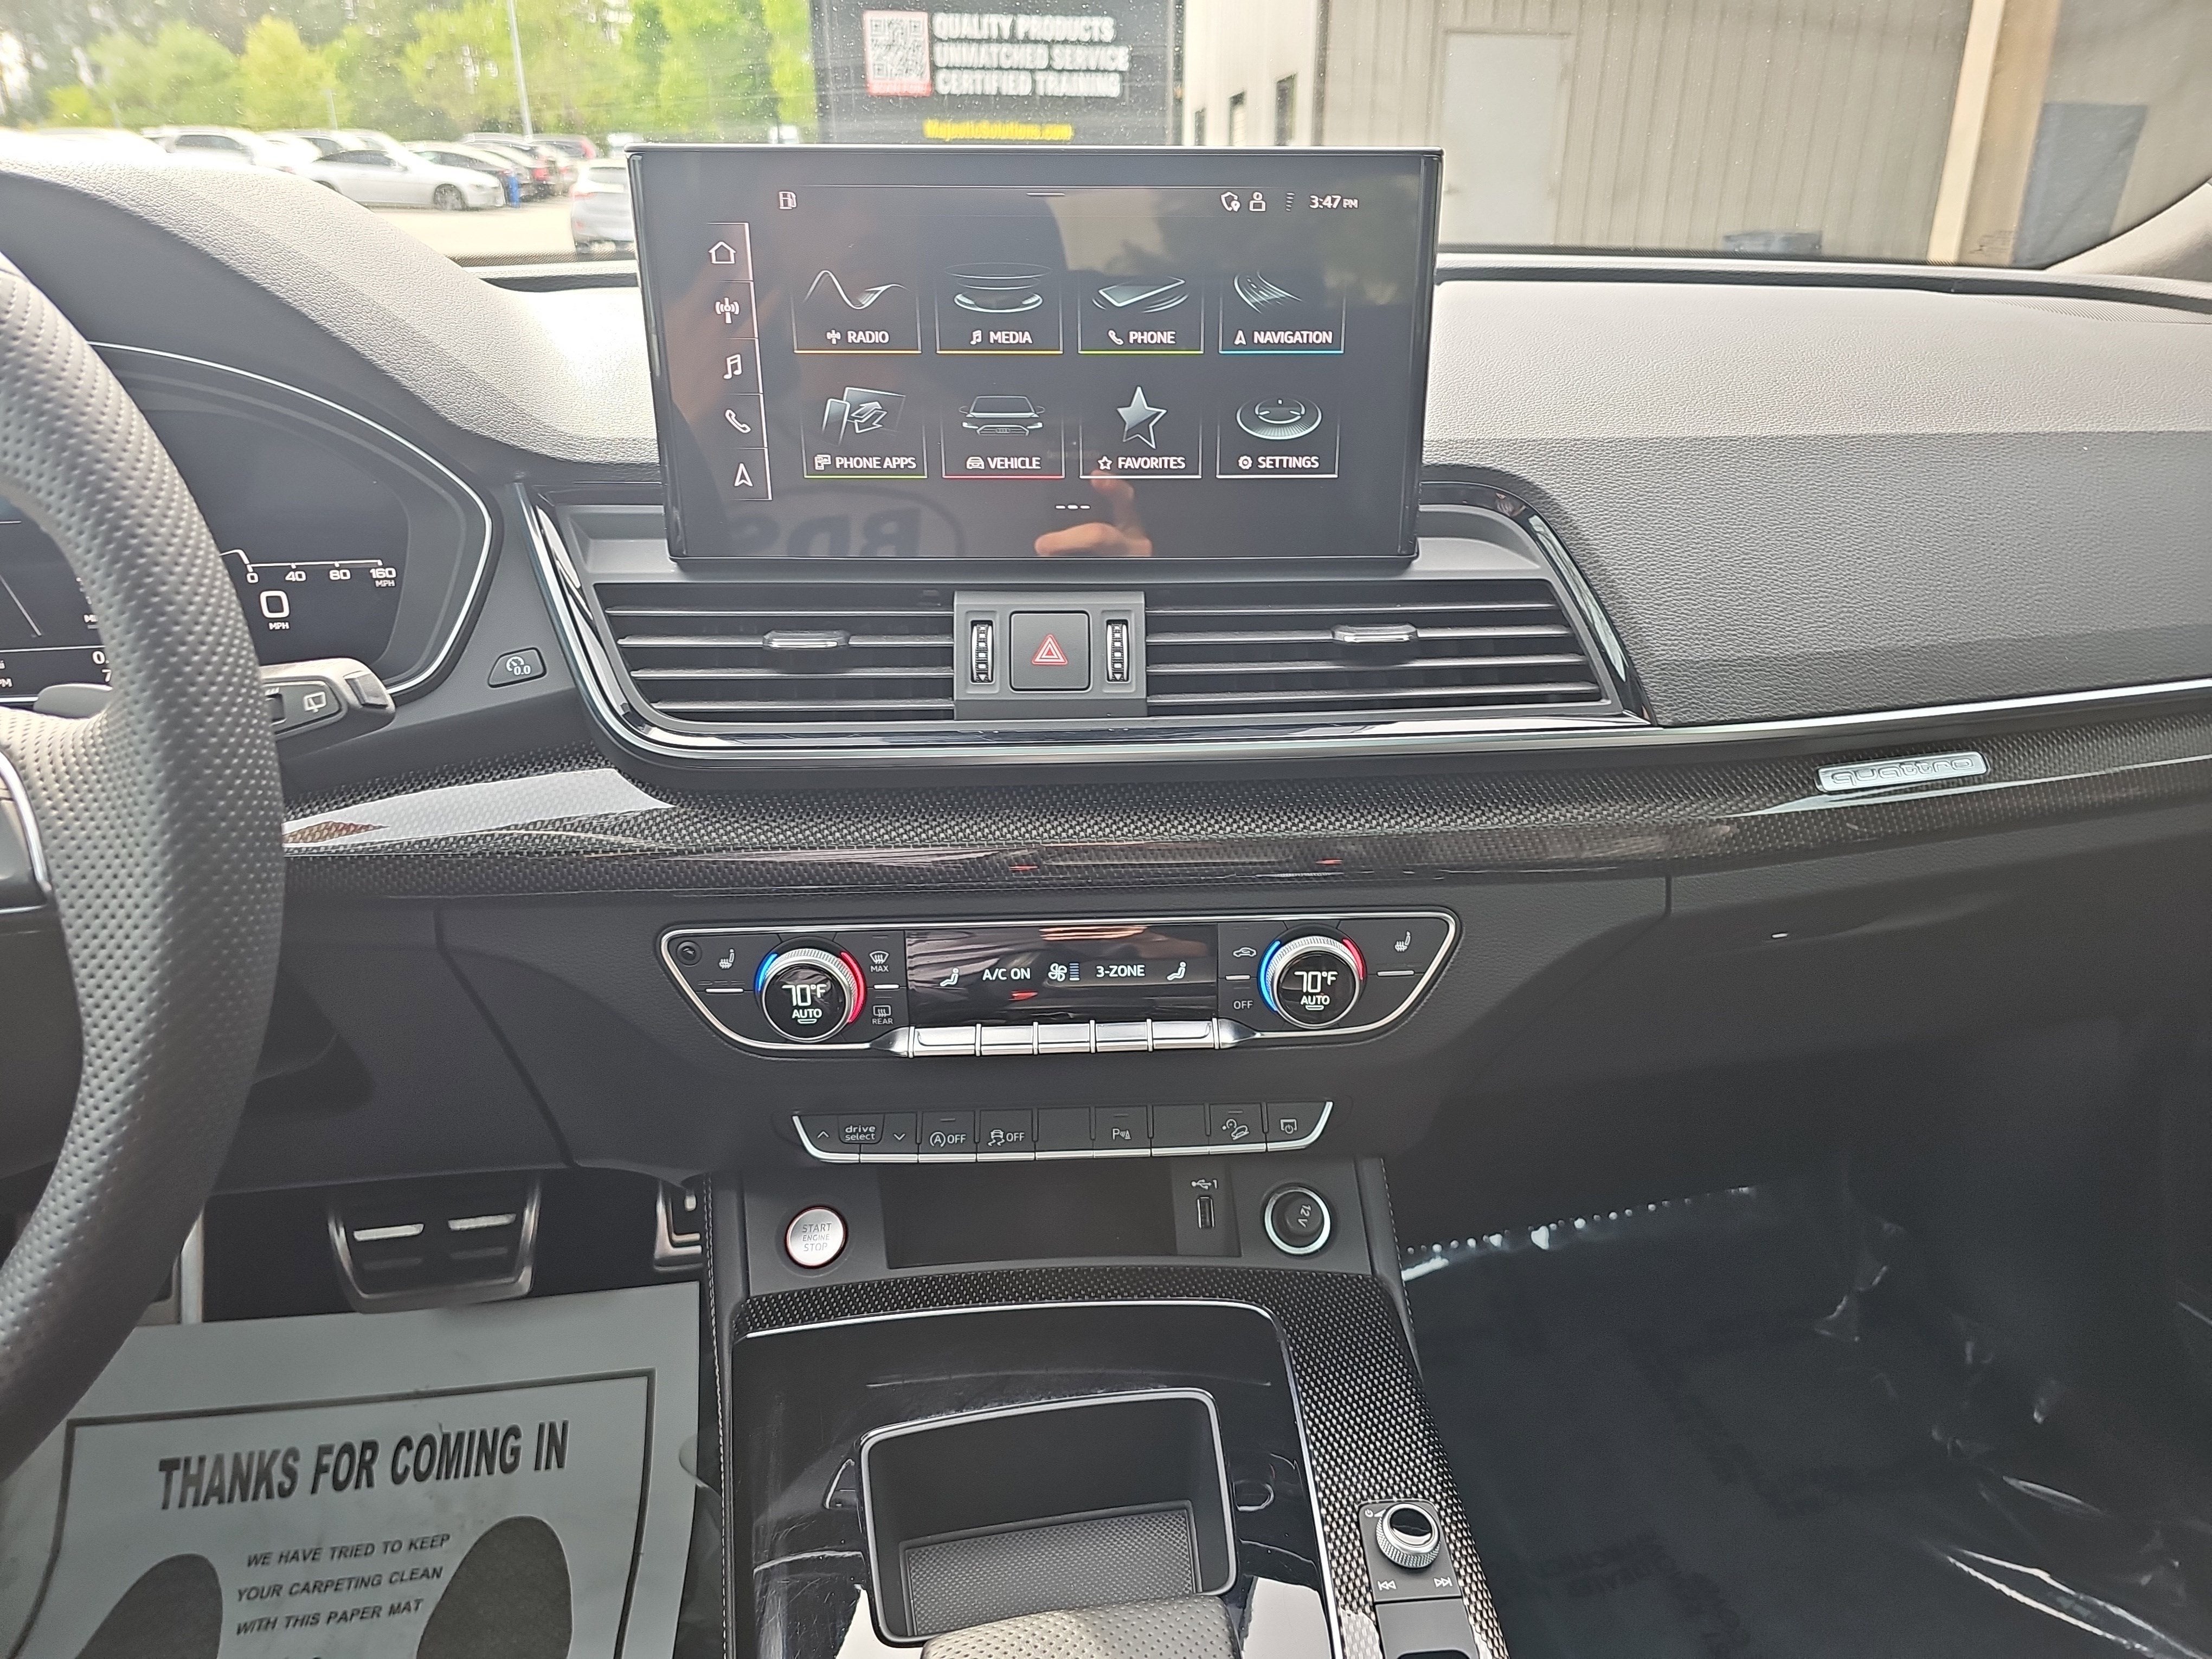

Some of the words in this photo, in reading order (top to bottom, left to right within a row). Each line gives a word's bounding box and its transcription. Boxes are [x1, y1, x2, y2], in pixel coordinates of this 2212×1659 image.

[934, 12, 1013, 40] QUALITY
[1017, 15, 1114, 42] PRODUCTS
[935, 43, 1049, 68] UNMATCHED
[1053, 46, 1129, 72] SERVICE
[936, 69, 1032, 94] CERTIFIED
[1036, 72, 1120, 97] TRAINING
[1309, 195, 1341, 209] 3:47
[1342, 199, 1358, 209] PM
[847, 330, 889, 344] RADIO
[989, 330, 1033, 344] MEDIA
[1128, 330, 1176, 344] PHONE
[1253, 330, 1333, 344] NAVIGATION
[835, 456, 882, 470] PHONE
[883, 456, 917, 470] APPS
[987, 456, 1041, 470] VEHICLE
[1117, 456, 1186, 470] FAVORITES
[1257, 456, 1320, 470] SETTINGS
[247, 573, 259, 583] 0
[285, 571, 306, 582] 40
[329, 569, 351, 580] 80
[369, 568, 396, 579] 160
[260, 590, 290, 618] 0
[268, 622, 290, 630] MPH
[1831, 757, 1975, 786] quattro
[982, 968, 1007, 981] A/C
[1010, 968, 1031, 980] ON
[1095, 964, 1146, 978] 3-ZONE
[1233, 1000, 1253, 1010] OFF
[1301, 995, 1330, 1006] AUTO
[792, 1008, 822, 1019] AUTO
[845, 1124, 876, 1133] drive
[845, 1133, 876, 1141] select
[947, 1134, 967, 1144] OFF
[1006, 1132, 1025, 1142] OFF
[1297, 1204, 1312, 1228] 12V
[802, 1223, 832, 1233] START
[803, 1243, 828, 1252] STOP
[158, 1446, 299, 1510] THANKS
[311, 1441, 380, 1495] FOR
[390, 1423, 522, 1486] COMING
[533, 1419, 570, 1471] IN
[247, 1551, 272, 1568] WE
[278, 1546, 323, 1564] HAVE
[329, 1542, 376, 1560] TRIED
[382, 1540, 404, 1555] TO
[408, 1533, 451, 1551] KEEP
[237, 1583, 284, 1602] YOUR
[288, 1573, 383, 1597] CARPETING
[388, 1566, 445, 1584] CLEAN
[236, 1616, 278, 1636] WITH
[285, 1612, 321, 1629] THIS
[326, 1605, 382, 1625] PAPER
[387, 1598, 425, 1617] MAT
